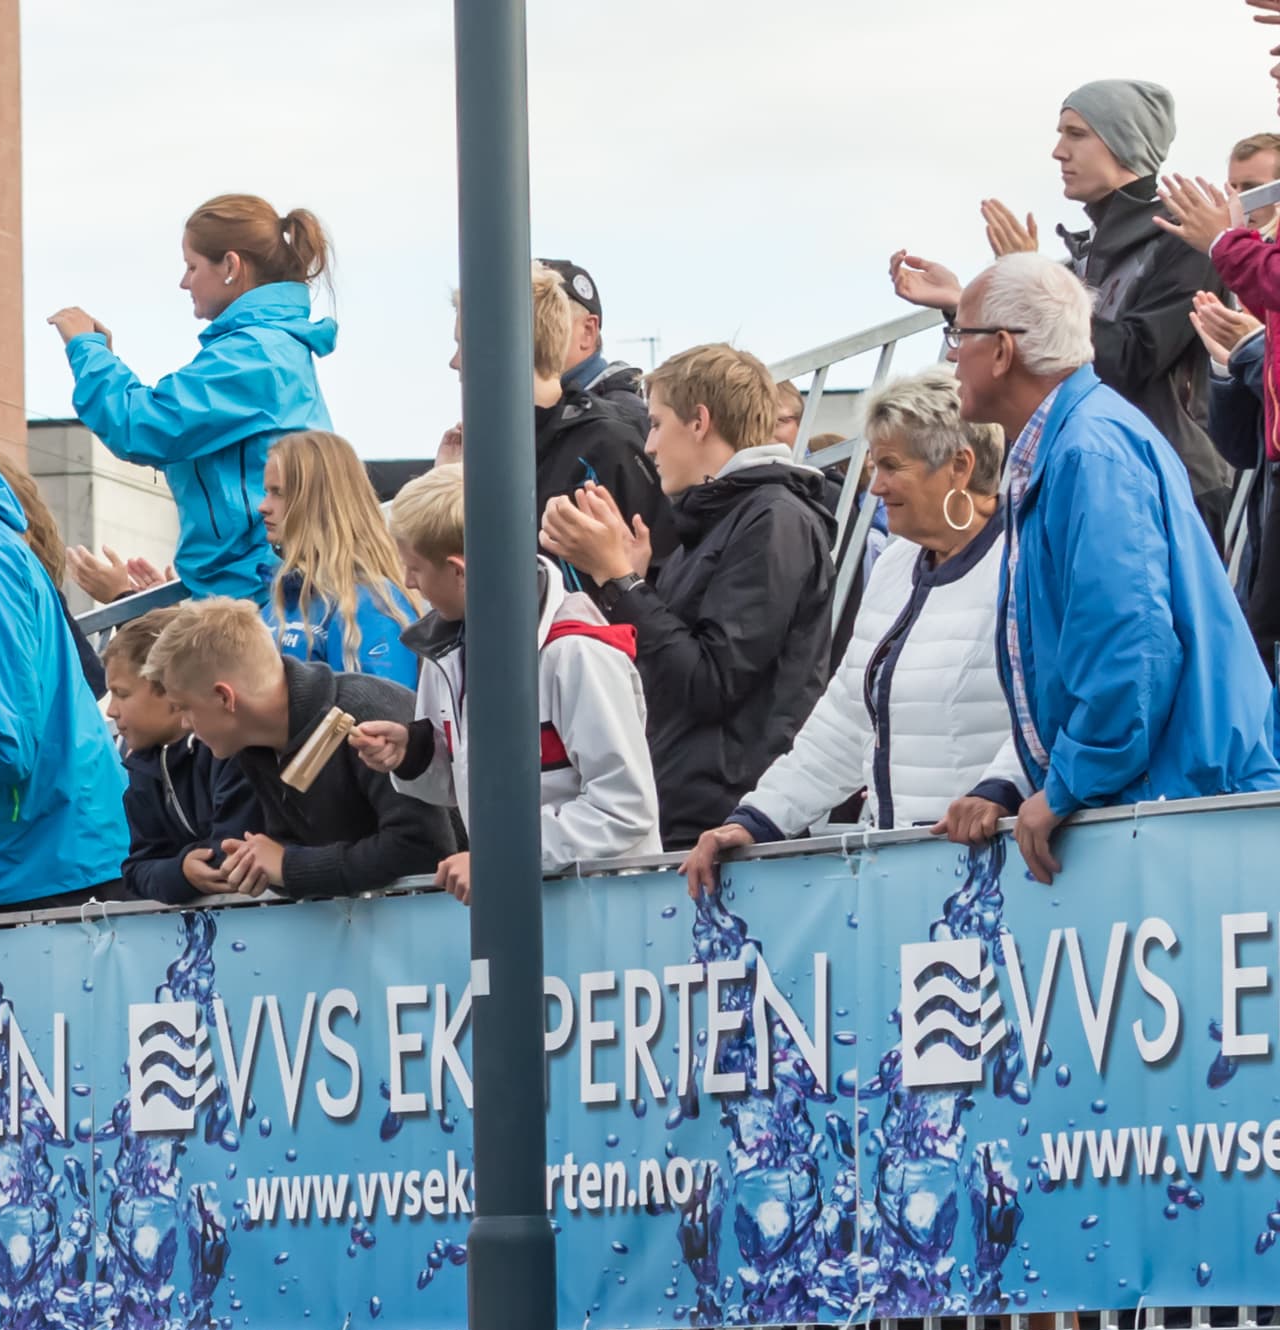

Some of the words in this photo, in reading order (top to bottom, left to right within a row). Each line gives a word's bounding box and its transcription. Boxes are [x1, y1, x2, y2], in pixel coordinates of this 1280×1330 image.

[212, 989, 360, 1129] VVS
[387, 950, 828, 1113] EKPERTEN
[1001, 917, 1179, 1079] VVS
[247, 1150, 694, 1222] www.vvsekrten.no
